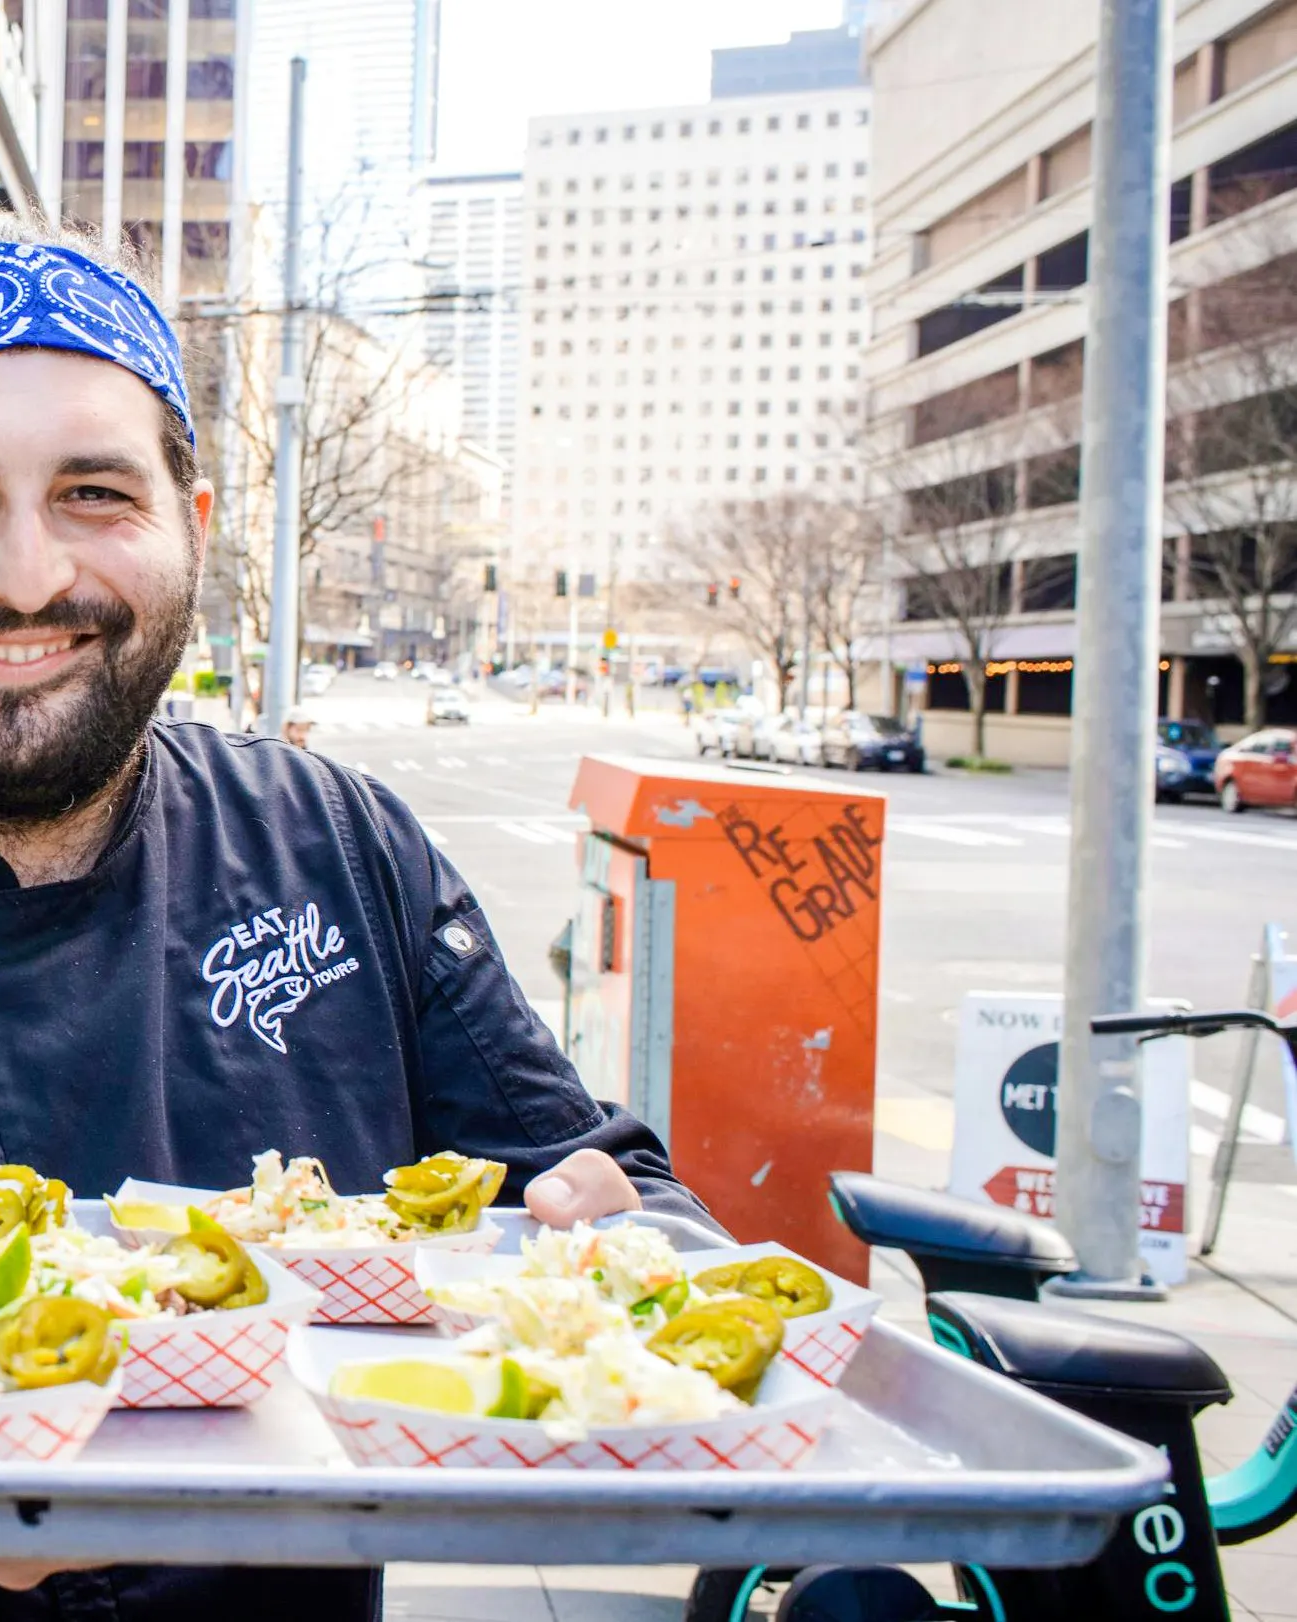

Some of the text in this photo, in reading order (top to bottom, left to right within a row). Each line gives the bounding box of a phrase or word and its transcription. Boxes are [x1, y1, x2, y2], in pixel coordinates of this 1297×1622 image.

[724, 819, 808, 879] RE
[769, 803, 883, 942] GRADE
[231, 907, 289, 950] EAT
[202, 902, 345, 1028] Seattle
[312, 957, 360, 988] TOURS
[978, 1008, 1043, 1030] NOW
[1004, 1082, 1048, 1111] MET
[1133, 1443, 1196, 1613] eo
